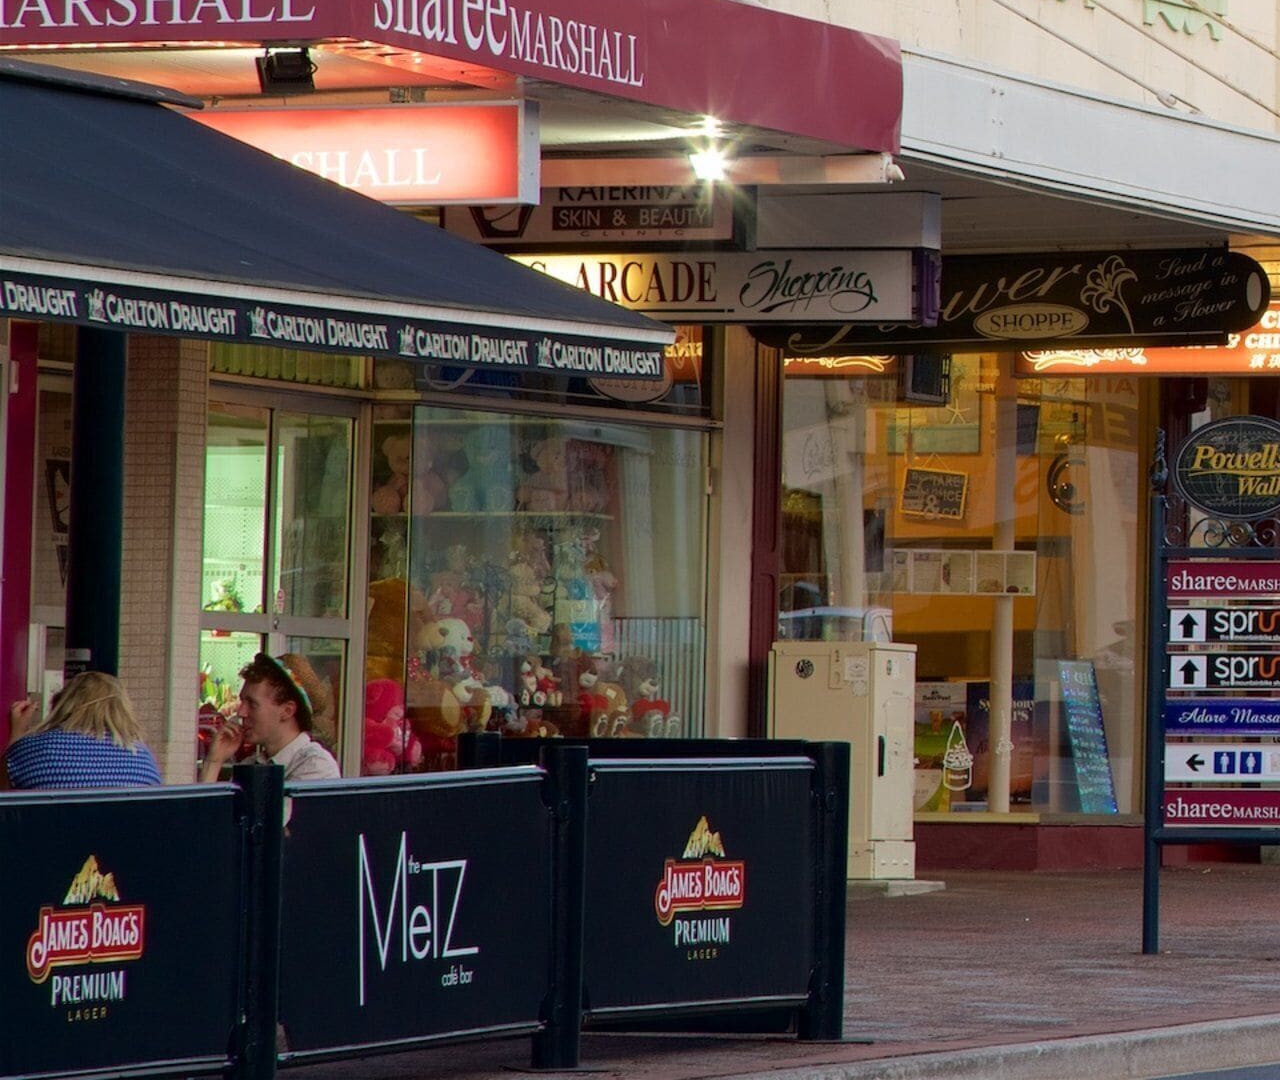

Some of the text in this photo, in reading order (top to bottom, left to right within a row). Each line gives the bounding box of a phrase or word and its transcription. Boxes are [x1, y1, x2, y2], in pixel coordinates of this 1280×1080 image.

[559, 208, 708, 228] SKIN & BEAUTY
[579, 229, 686, 238] CLINIC
[4, 280, 77, 318] DRAUGHT
[1140, 278, 1214, 305] message
[105, 295, 236, 336] CARLTON DRAUGHT
[989, 311, 1075, 332] SHOPPE
[266, 312, 391, 351] CARLTON DRAUGHT
[415, 328, 528, 365] CARLTON DRAUGHT
[551, 341, 661, 376] CARLTON DRAUGHT
[1178, 707, 1228, 724] Adore
[659, 866, 702, 913] JAMES
[31, 915, 89, 969] JAMES
[674, 917, 730, 947] PREMIUM
[687, 948, 718, 961] LAGER
[51, 970, 125, 1007] PREMIUM
[459, 964, 474, 984] bar
[67, 1006, 108, 1022] LAGER
